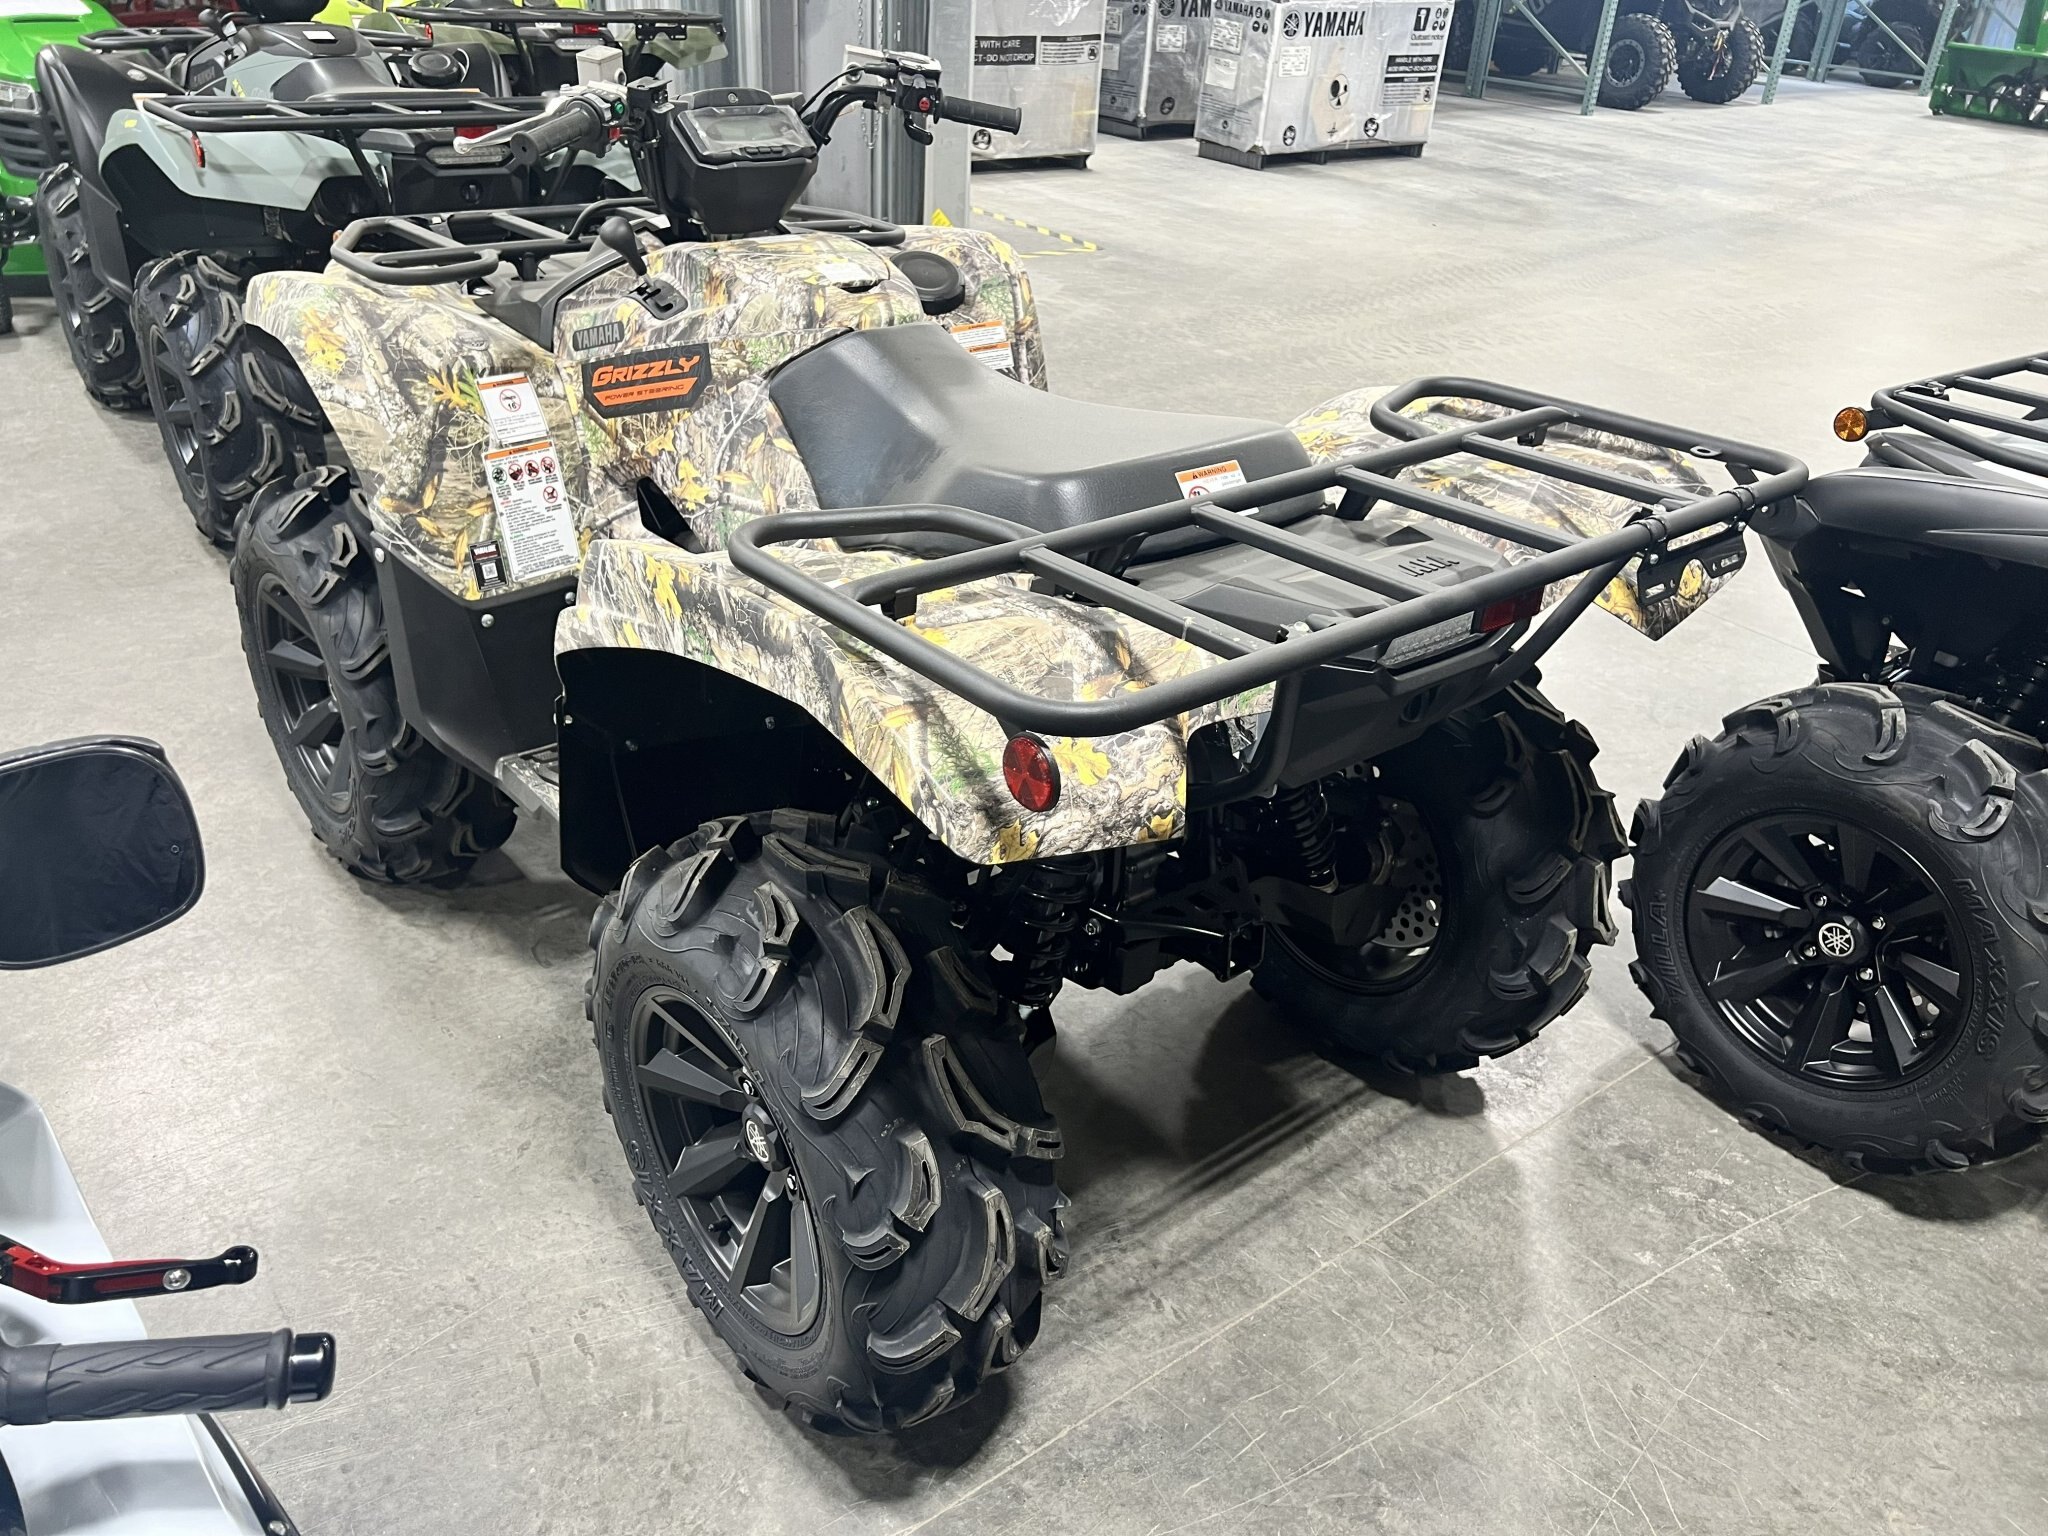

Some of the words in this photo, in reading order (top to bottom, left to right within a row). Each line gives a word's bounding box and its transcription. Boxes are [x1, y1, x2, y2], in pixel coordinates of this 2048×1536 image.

[1180, 0, 1211, 17] YAM
[1224, 1, 1254, 18] YAMAHA
[1304, 11, 1366, 37] YAMAHA
[979, 40, 1001, 49] WITH
[1002, 40, 1021, 48] CARE
[575, 322, 621, 350] YAMAHA
[591, 355, 701, 387] GRIZZLY
[604, 392, 635, 401] POWER
[636, 384, 685, 396] STEERING
[507, 402, 517, 410] 16
[1198, 466, 1227, 478] WARNING
[1952, 877, 2008, 1060] MAXXIS
[628, 1139, 725, 1319] MAXXIS
